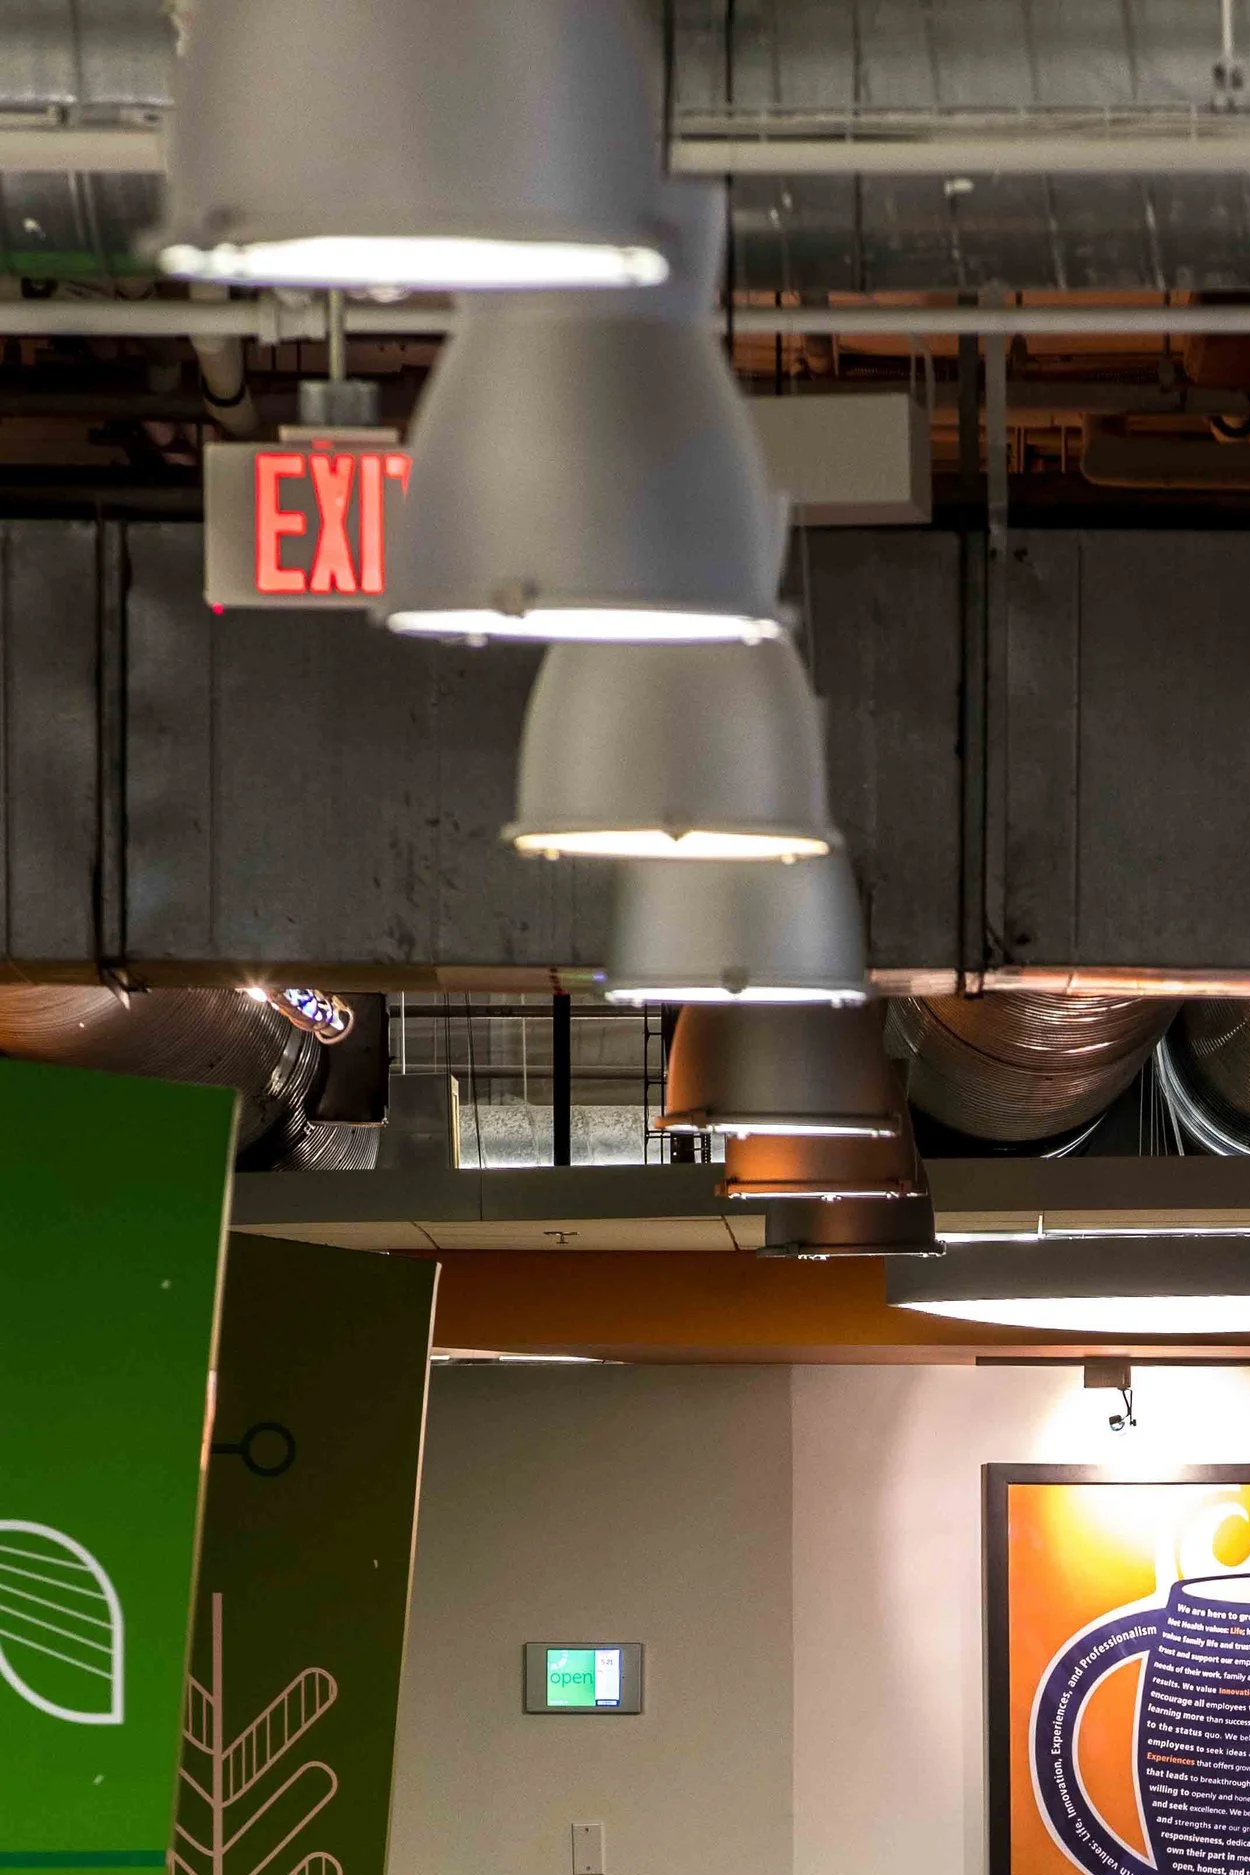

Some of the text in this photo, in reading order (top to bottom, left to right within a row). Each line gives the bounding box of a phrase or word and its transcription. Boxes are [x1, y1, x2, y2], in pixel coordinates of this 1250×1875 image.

[255, 452, 413, 595] EXI
[1177, 1603, 1191, 1614] We
[1191, 1608, 1206, 1617] are
[1206, 1609, 1227, 1619] here
[1227, 1612, 1238, 1620] to
[1079, 1625, 1157, 1669] Professionalism
[550, 1672, 593, 1688] open
[1067, 1666, 1084, 1688] and
[1152, 1677, 1180, 1688] results.
[1182, 1682, 1194, 1691] We
[1195, 1685, 1217, 1694] value
[1051, 1690, 1073, 1755] Experiences,
[1147, 1739, 1194, 1751] employees
[1196, 1745, 1205, 1753] to
[1206, 1747, 1224, 1755] seek
[1226, 1748, 1247, 1757] ideas
[1146, 1768, 1164, 1777] that
[1165, 1770, 1189, 1781] leads
[1053, 1758, 1077, 1818] Innovation,
[1075, 1818, 1091, 1842] Life,
[1156, 1816, 1173, 1824] and
[1174, 1819, 1211, 1829] strengths
[1088, 1840, 1118, 1870] values:
[1166, 1847, 1184, 1855] own
[1186, 1848, 1206, 1858] their
[1207, 1852, 1225, 1860] part
[1226, 1852, 1235, 1861] in
[1172, 1862, 1195, 1872] open,
[1196, 1864, 1227, 1875] honest,
